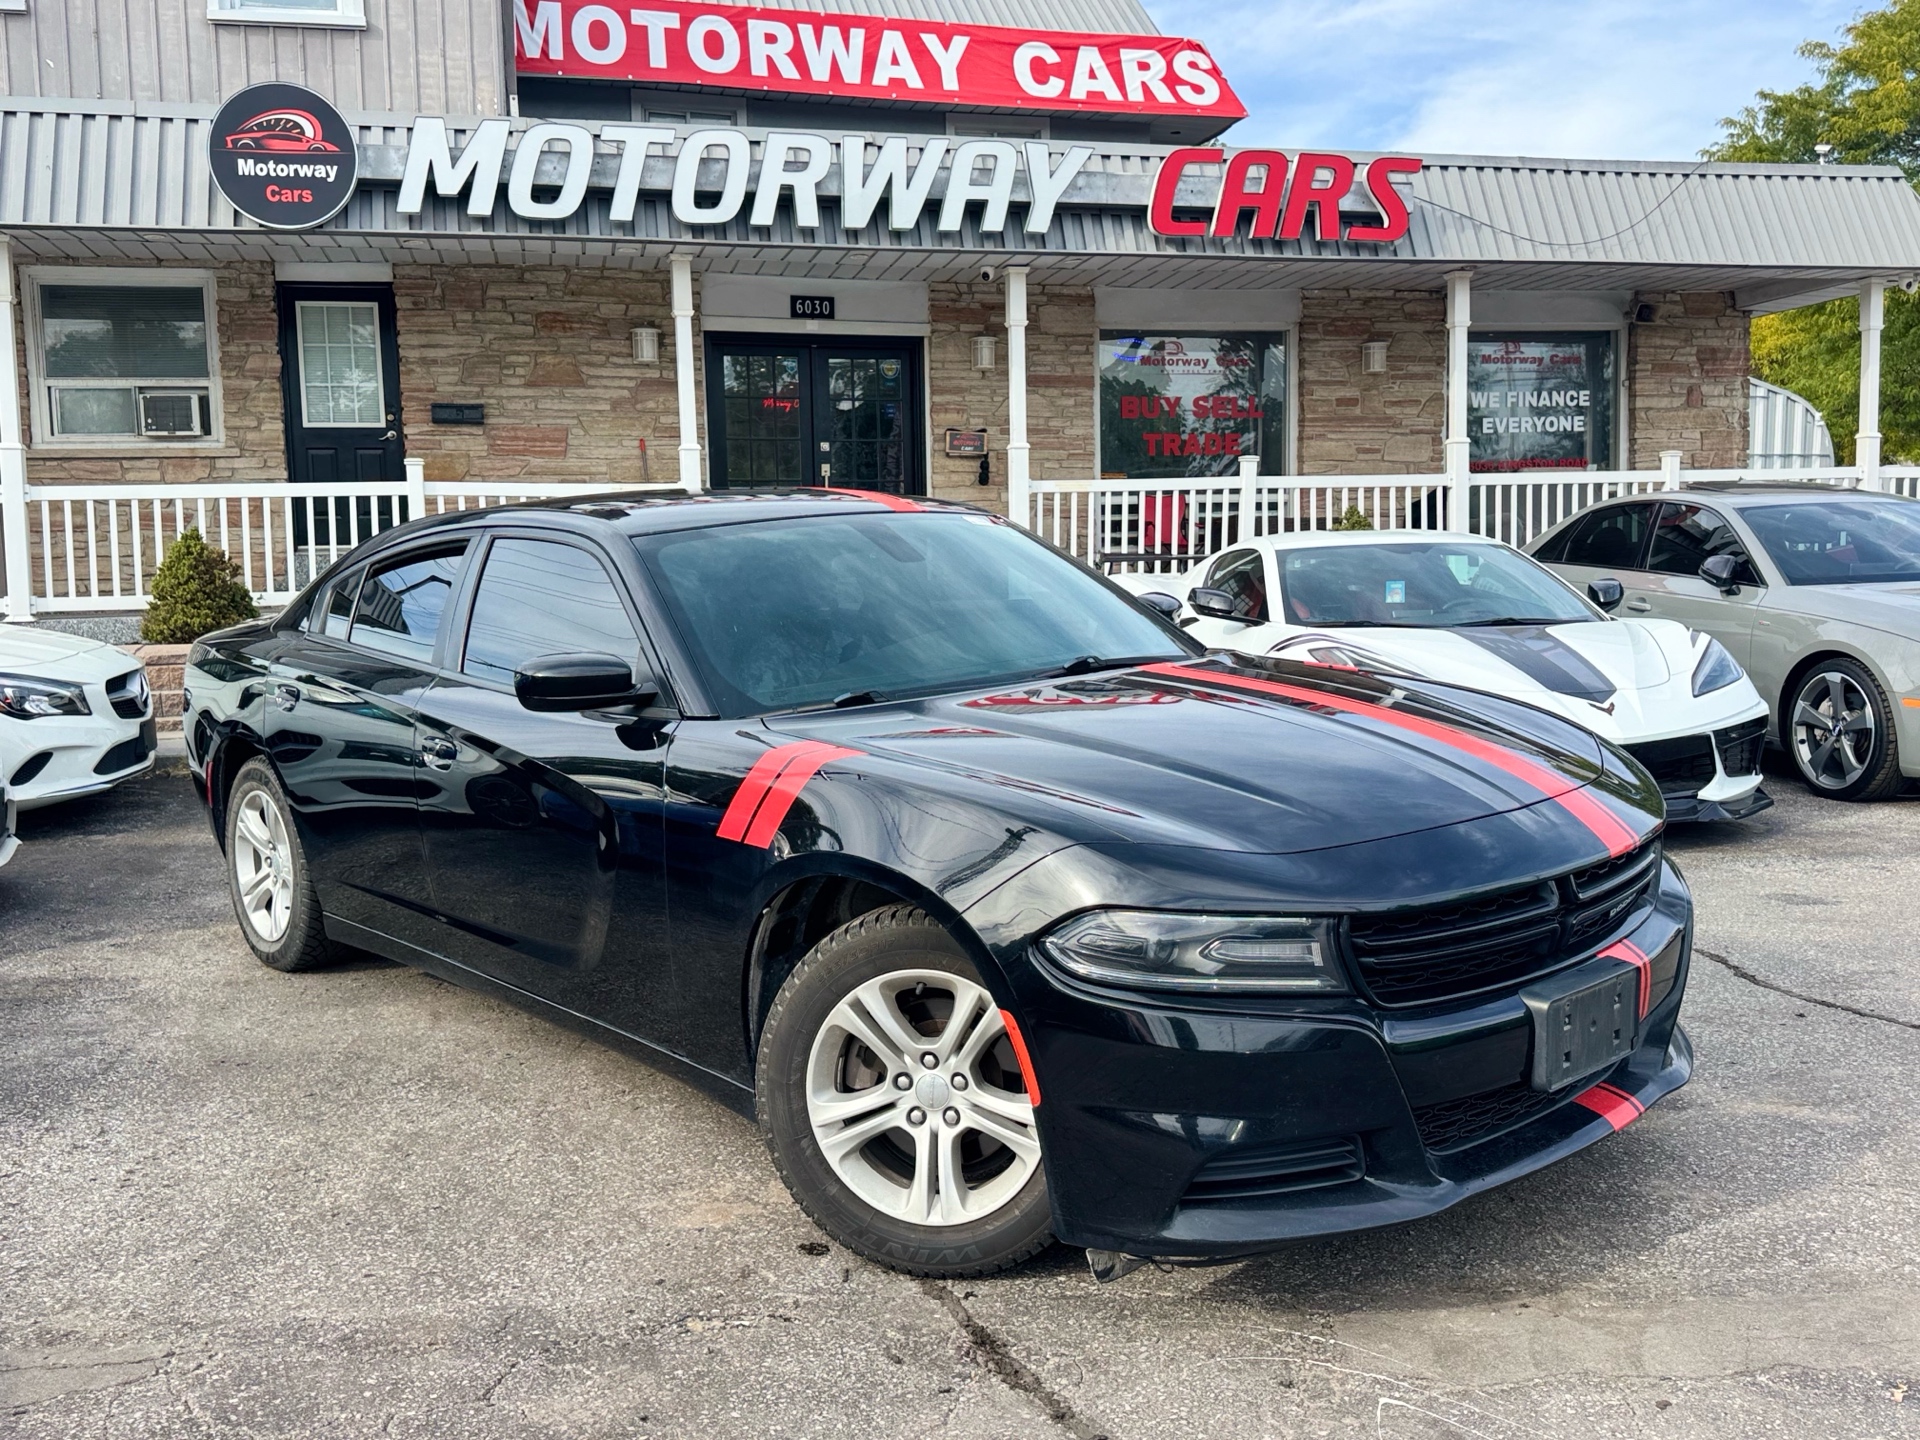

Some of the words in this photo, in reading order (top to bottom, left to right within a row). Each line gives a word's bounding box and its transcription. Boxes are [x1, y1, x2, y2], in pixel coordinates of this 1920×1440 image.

[514, 0, 970, 92] MOTORWAY
[1013, 41, 1221, 106] CARS
[237, 158, 338, 183] Motorway
[395, 116, 1095, 235] MOTORWAY
[1147, 148, 1423, 244] CARS
[265, 185, 313, 204] Cars
[796, 299, 830, 315] 6030
[1140, 355, 1209, 369] Motorway
[1481, 354, 1544, 367] Motorway
[1120, 396, 1182, 419] BUY
[1192, 395, 1265, 419] SELL
[1471, 391, 1500, 408] WE
[1506, 390, 1591, 407] FINANCE
[1482, 416, 1585, 434] EVERYONE
[1142, 433, 1242, 457] TRADE
[1497, 459, 1555, 470] KINGSTON
[1559, 458, 1589, 469] ROAD
